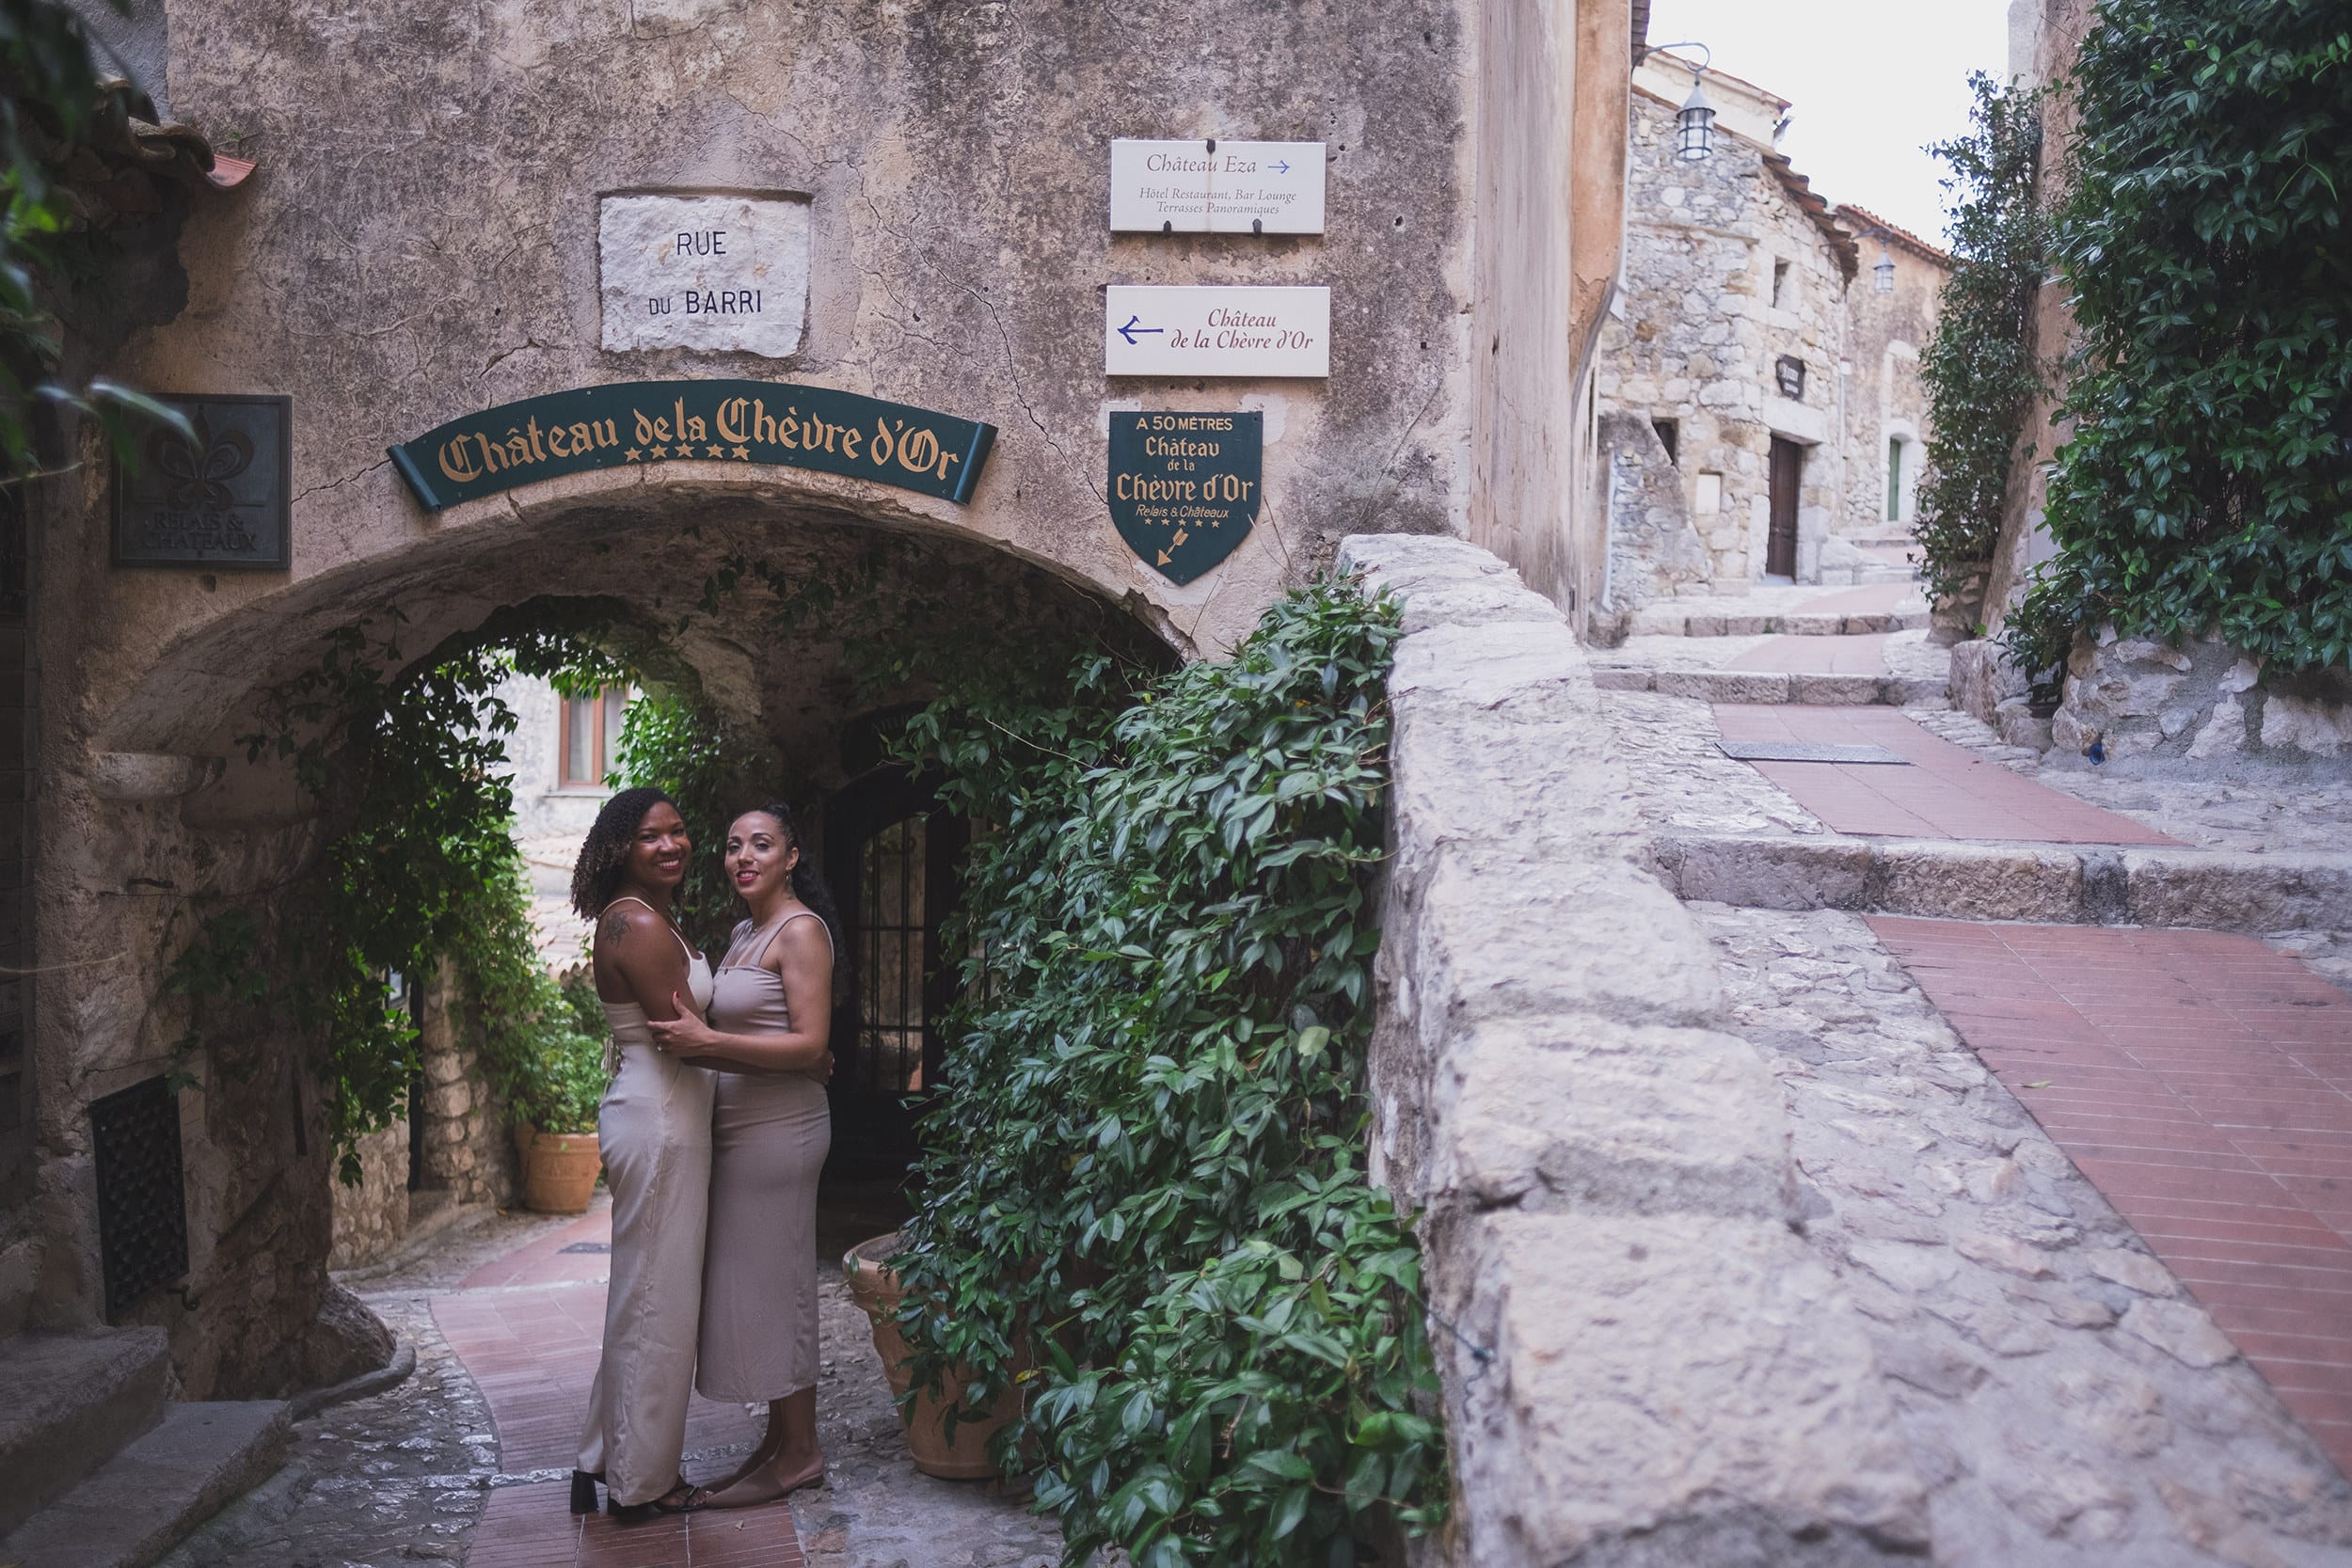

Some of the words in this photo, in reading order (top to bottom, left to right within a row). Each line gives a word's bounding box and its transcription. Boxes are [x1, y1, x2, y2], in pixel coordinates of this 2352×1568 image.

[1147, 153, 1218, 173] Château
[1223, 155, 1257, 173] Eza
[1139, 187, 1168, 199] Hôtel
[1172, 188, 1232, 200] Restaurant,
[1235, 189, 1254, 200] Bar
[1258, 189, 1296, 204] Lounge
[1156, 201, 1203, 213] Terrasses
[1207, 202, 1279, 217] Panoramiques
[676, 231, 727, 256] RUE
[648, 298, 671, 315] DU
[686, 290, 762, 315] BARRI
[1207, 308, 1277, 327] Château
[1170, 329, 1188, 349] de
[1193, 329, 1210, 349] la
[1216, 330, 1272, 350] Chèvre
[1276, 330, 1313, 350] d'Or
[1136, 417, 1149, 430] A
[1152, 416, 1176, 431] 50
[438, 414, 620, 483] Château
[716, 397, 863, 460] Chèvre
[870, 416, 960, 481] d'Or
[1145, 436, 1220, 457] Château
[1167, 458, 1181, 472] de
[1183, 458, 1196, 472] la
[1117, 472, 1198, 501] Chèvre
[1202, 473, 1255, 502] d'Or
[1136, 503, 1168, 517] Relais
[1170, 505, 1178, 517] &
[1180, 504, 1230, 519] Châteaux
